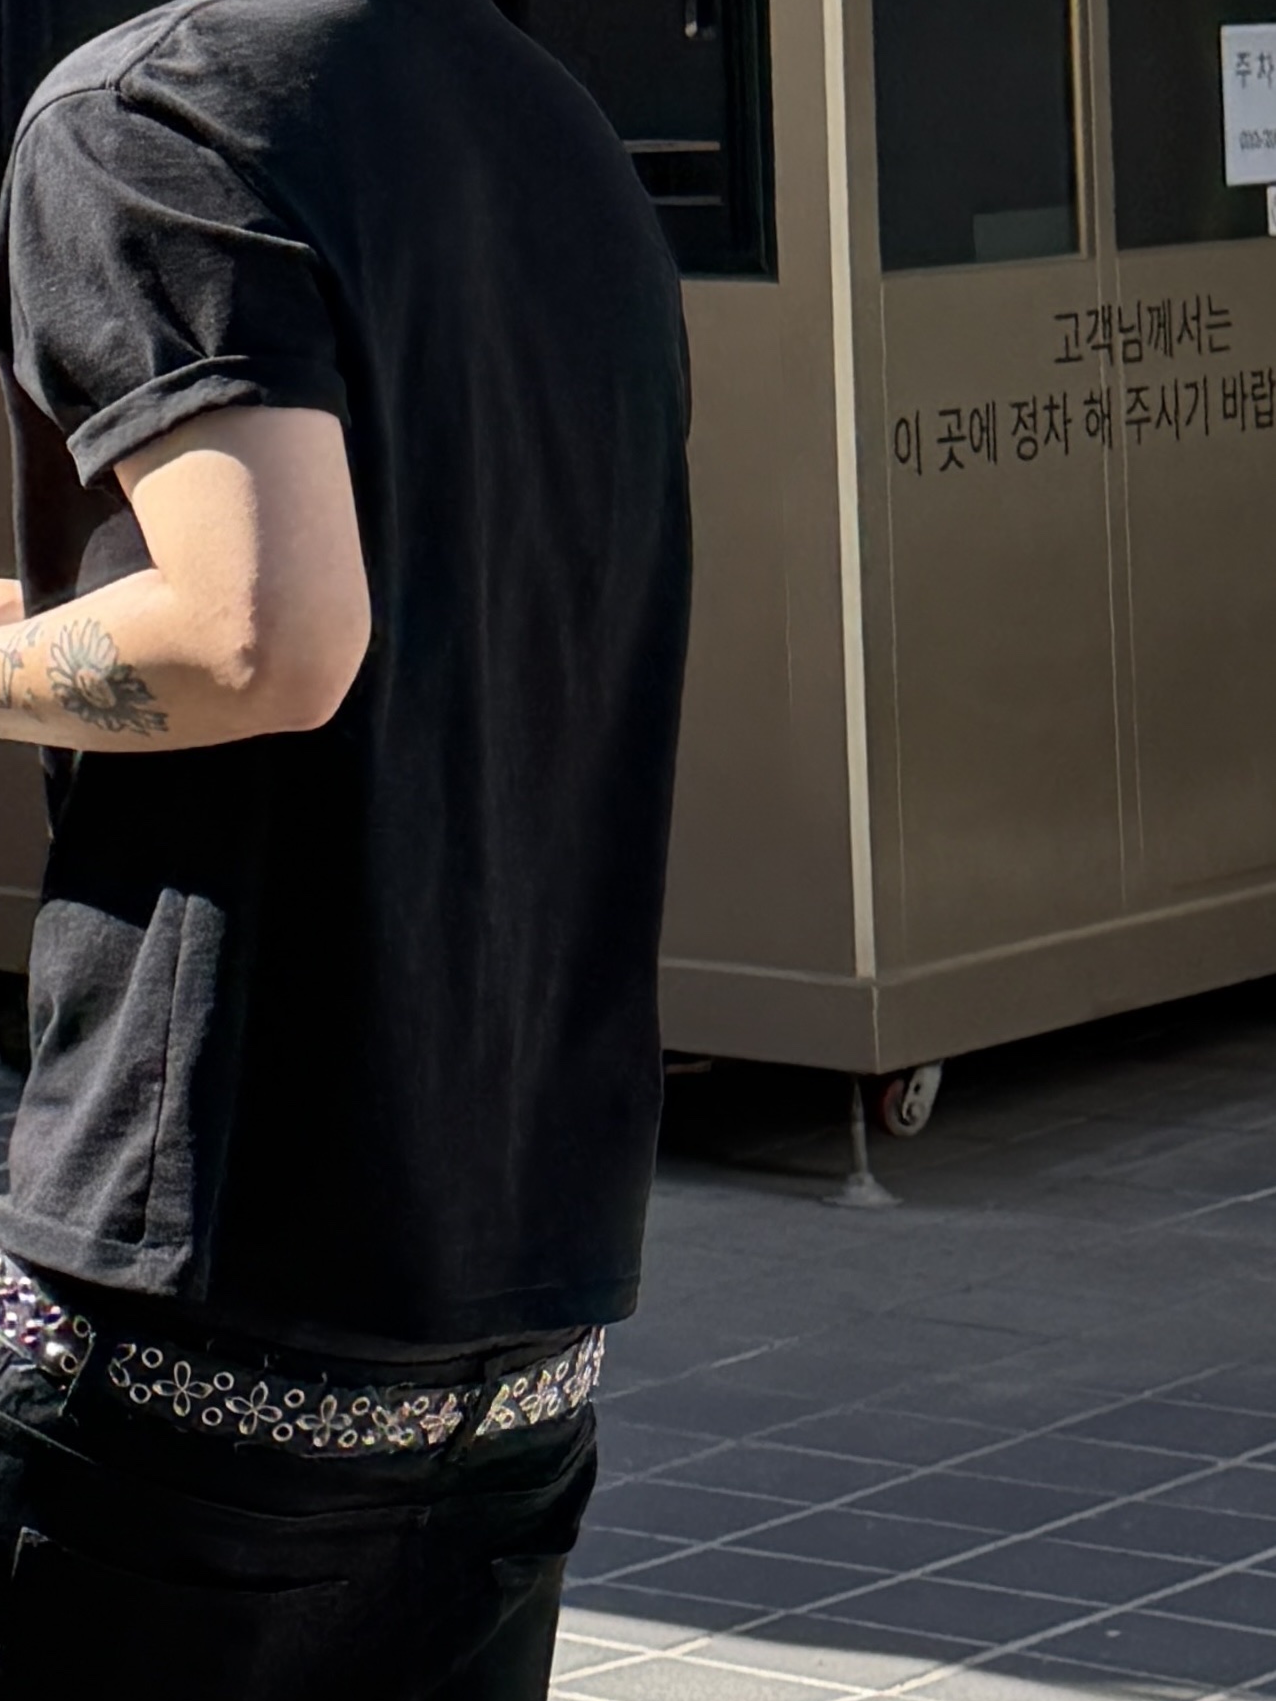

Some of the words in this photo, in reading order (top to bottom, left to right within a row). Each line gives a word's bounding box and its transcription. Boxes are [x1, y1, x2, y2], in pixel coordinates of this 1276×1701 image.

[1054, 294, 1232, 367] 고객님께서는
[894, 409, 922, 476] 이
[937, 400, 998, 472] 곳에
[1010, 391, 1072, 462] 정차
[1083, 386, 1113, 450] 해
[1125, 374, 1209, 446] 주시기
